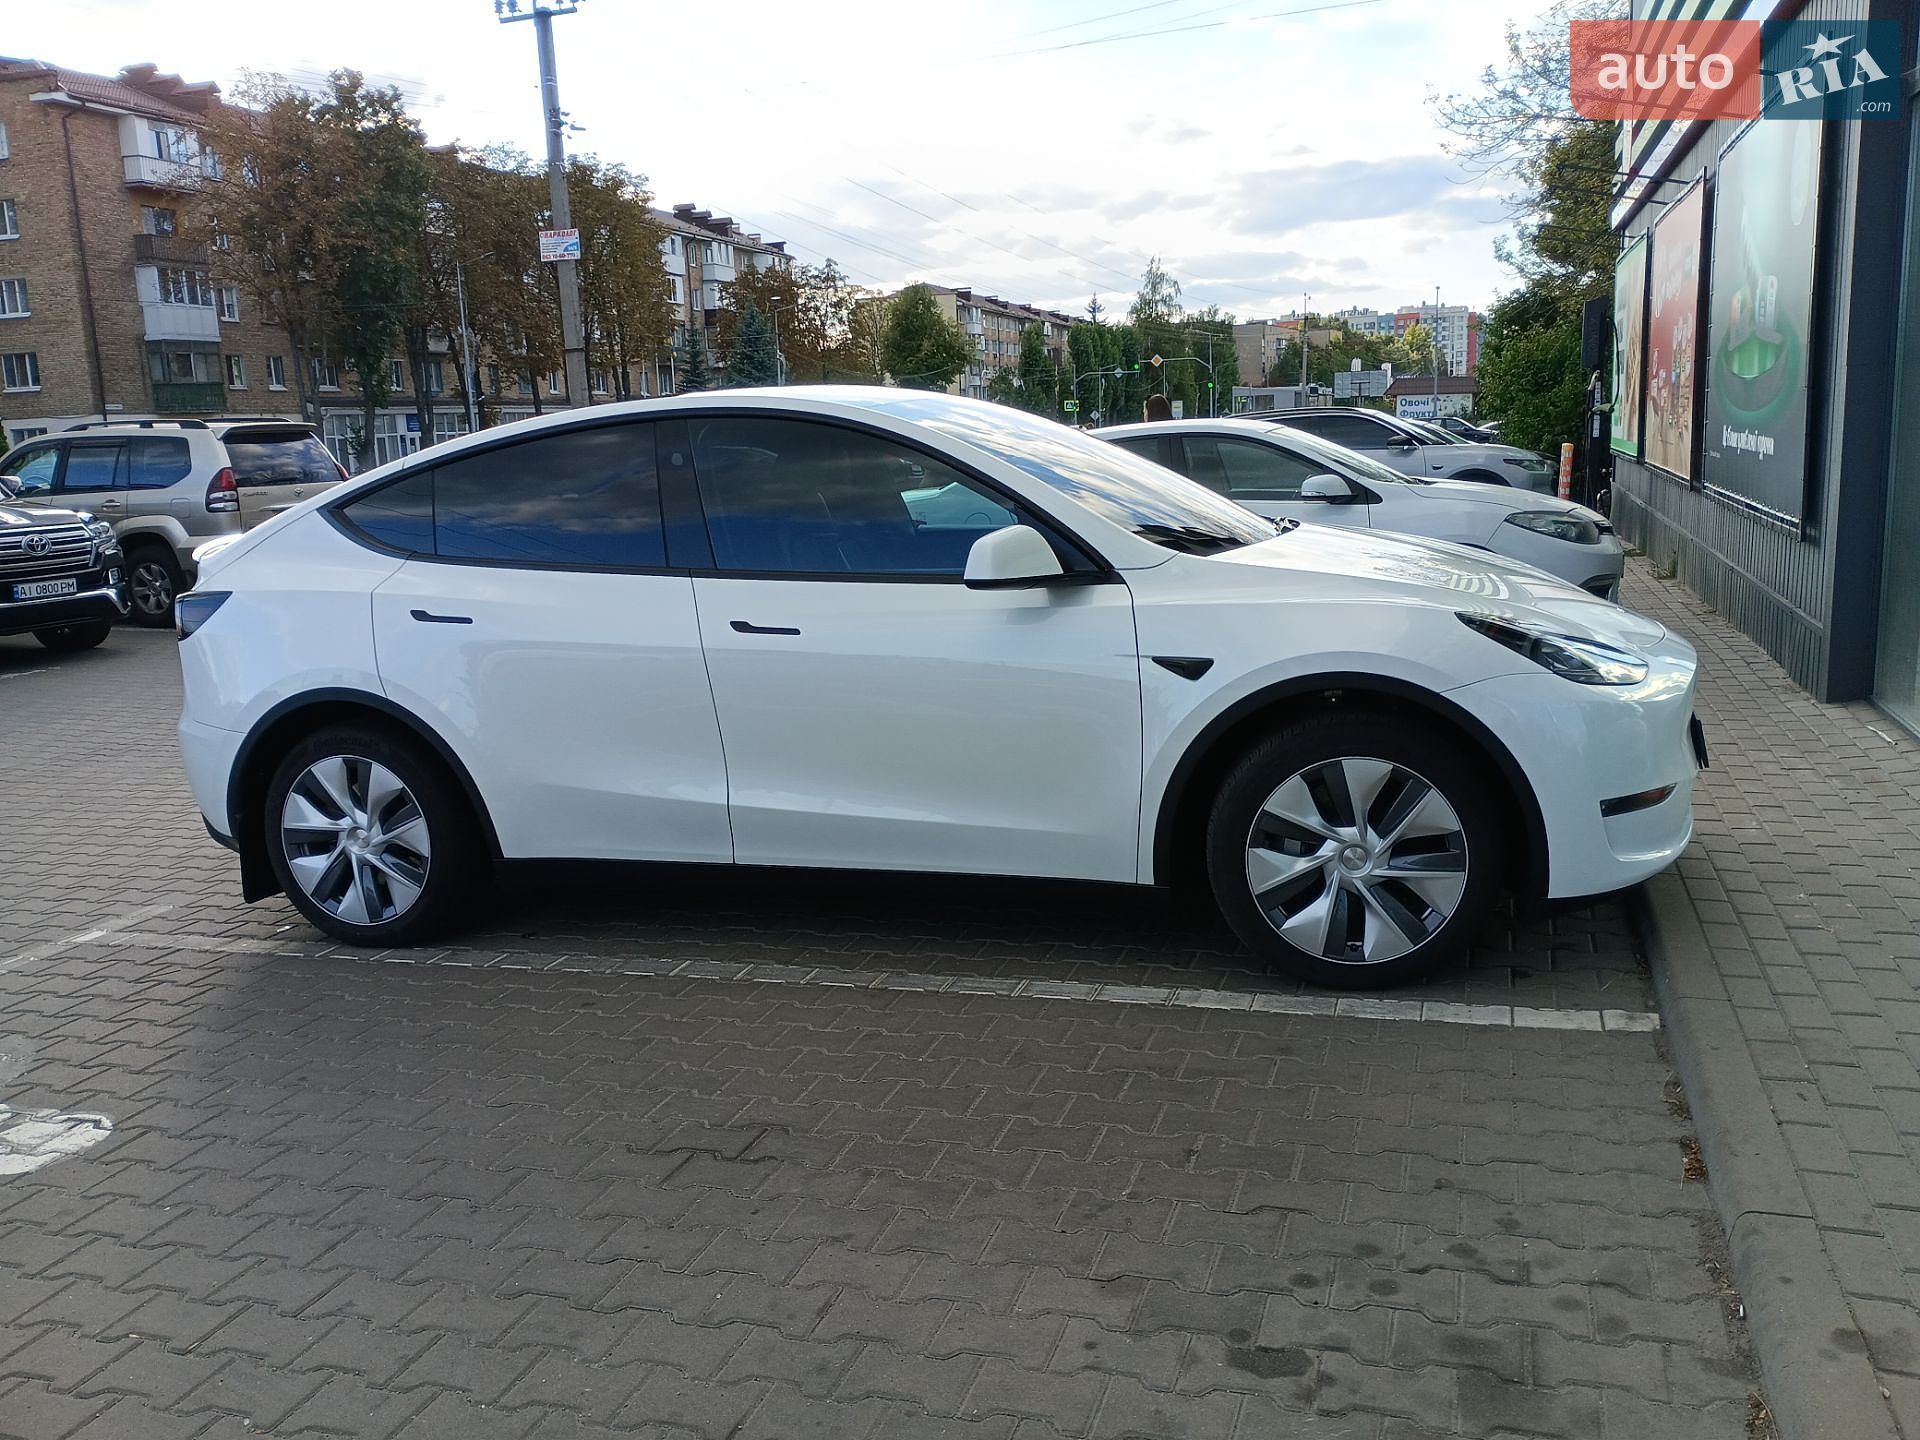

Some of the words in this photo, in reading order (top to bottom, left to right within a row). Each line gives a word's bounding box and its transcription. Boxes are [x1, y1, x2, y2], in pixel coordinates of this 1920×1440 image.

[1400, 397, 1429, 407] Овочі
[36, 583, 59, 595] 0800
[60, 581, 75, 592] PM
